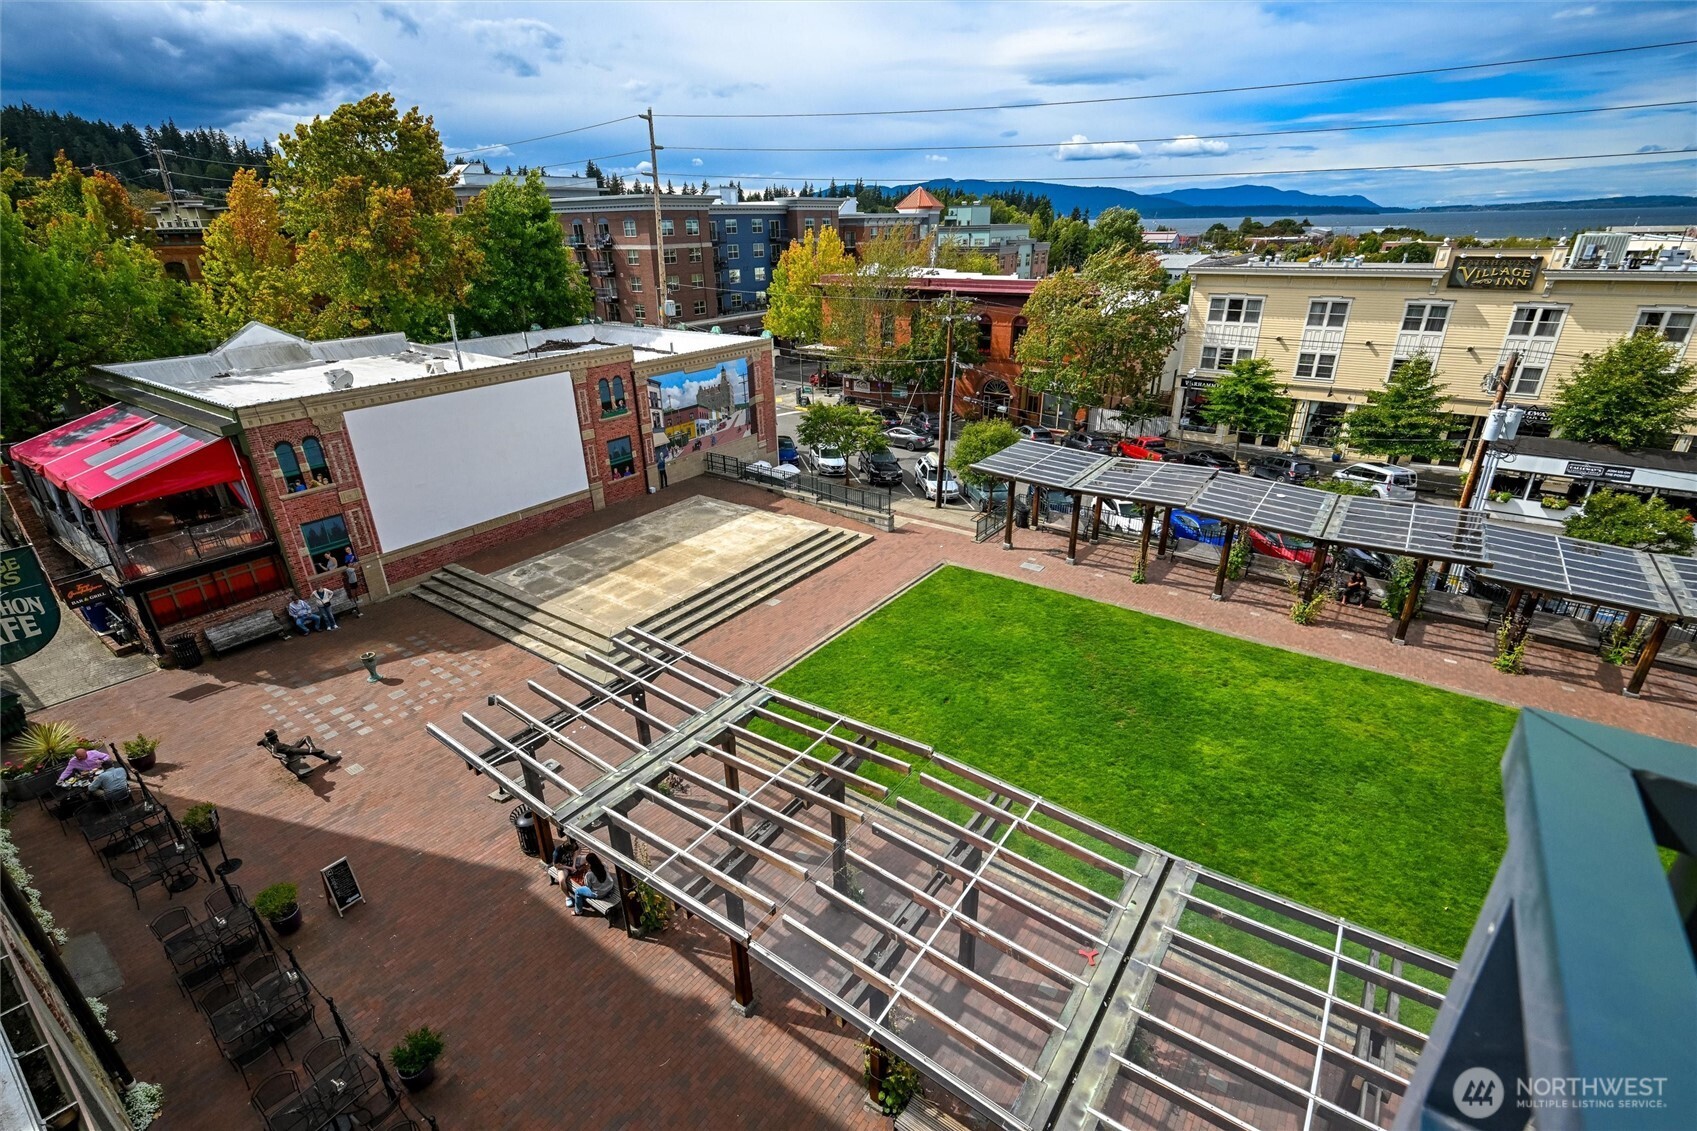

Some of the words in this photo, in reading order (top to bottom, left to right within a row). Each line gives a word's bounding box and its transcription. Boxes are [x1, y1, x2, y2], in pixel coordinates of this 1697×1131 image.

[1457, 266, 1532, 281] VILLAGE
[1495, 277, 1528, 286] INN
[70, 598, 84, 606] BAR
[89, 592, 107, 600] GRILL
